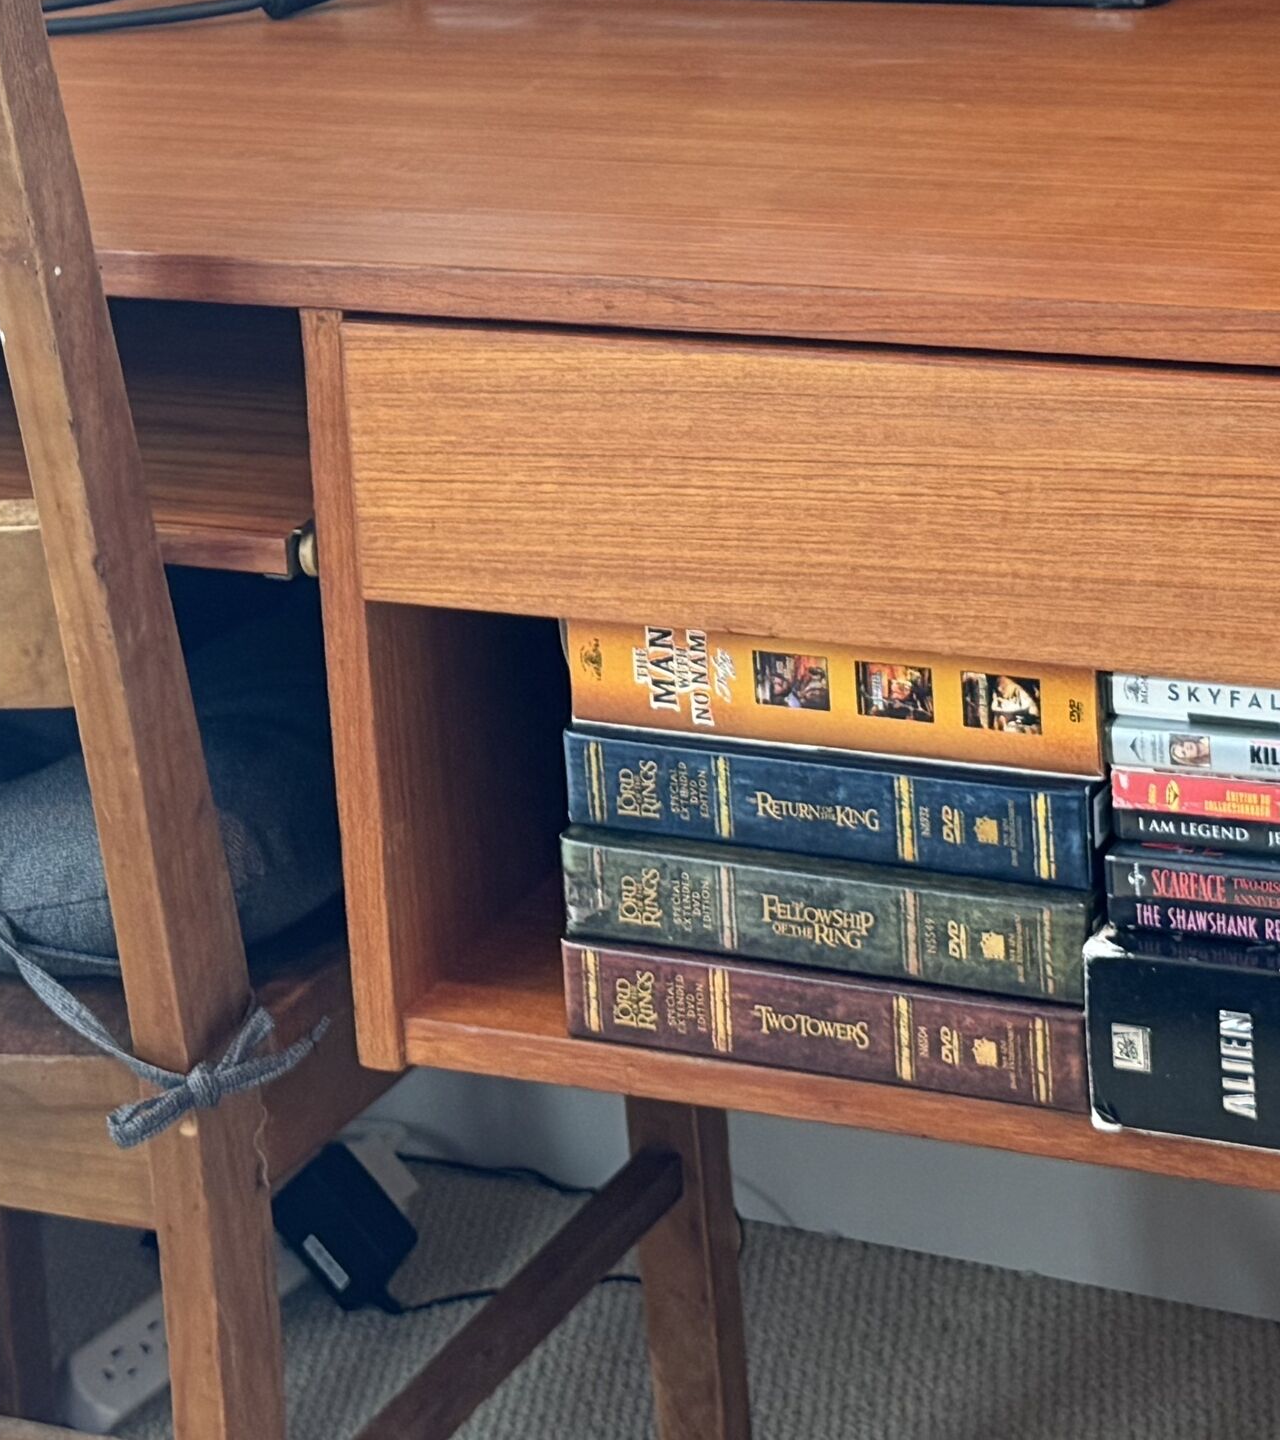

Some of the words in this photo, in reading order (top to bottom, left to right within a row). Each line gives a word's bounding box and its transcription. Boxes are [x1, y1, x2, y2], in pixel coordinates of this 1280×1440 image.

[647, 626, 679, 709] MAN
[676, 647, 690, 690] WITH
[687, 629, 709, 686] NAM
[693, 691, 713, 723] NO
[617, 767, 640, 817] LORD
[639, 760, 661, 819] RINGS
[754, 790, 820, 821] RETURN
[835, 804, 880, 832] KING
[942, 805, 956, 845] DVD
[1138, 816, 1144, 831] I
[1149, 818, 1176, 835] AM
[1180, 821, 1250, 842] LEGEND
[618, 875, 641, 924] LORD
[641, 867, 662, 928] RINGS
[692, 891, 701, 917] DVD
[701, 879, 713, 931] EDITION
[1151, 868, 1227, 903] SCARFACE
[761, 893, 875, 936] FELLOWSHIP
[1135, 902, 1162, 928] THE
[1167, 906, 1260, 939] SHAWSHANK
[813, 923, 863, 950] RING
[947, 920, 961, 959] DVD
[613, 977, 637, 1027] LORD
[636, 970, 658, 1031] RINGS
[686, 993, 696, 1019] DVD
[754, 1004, 797, 1035] TWO
[795, 1013, 870, 1050] TOWERS
[940, 1025, 954, 1065] DVD
[1219, 1009, 1258, 1121] ALIEN
